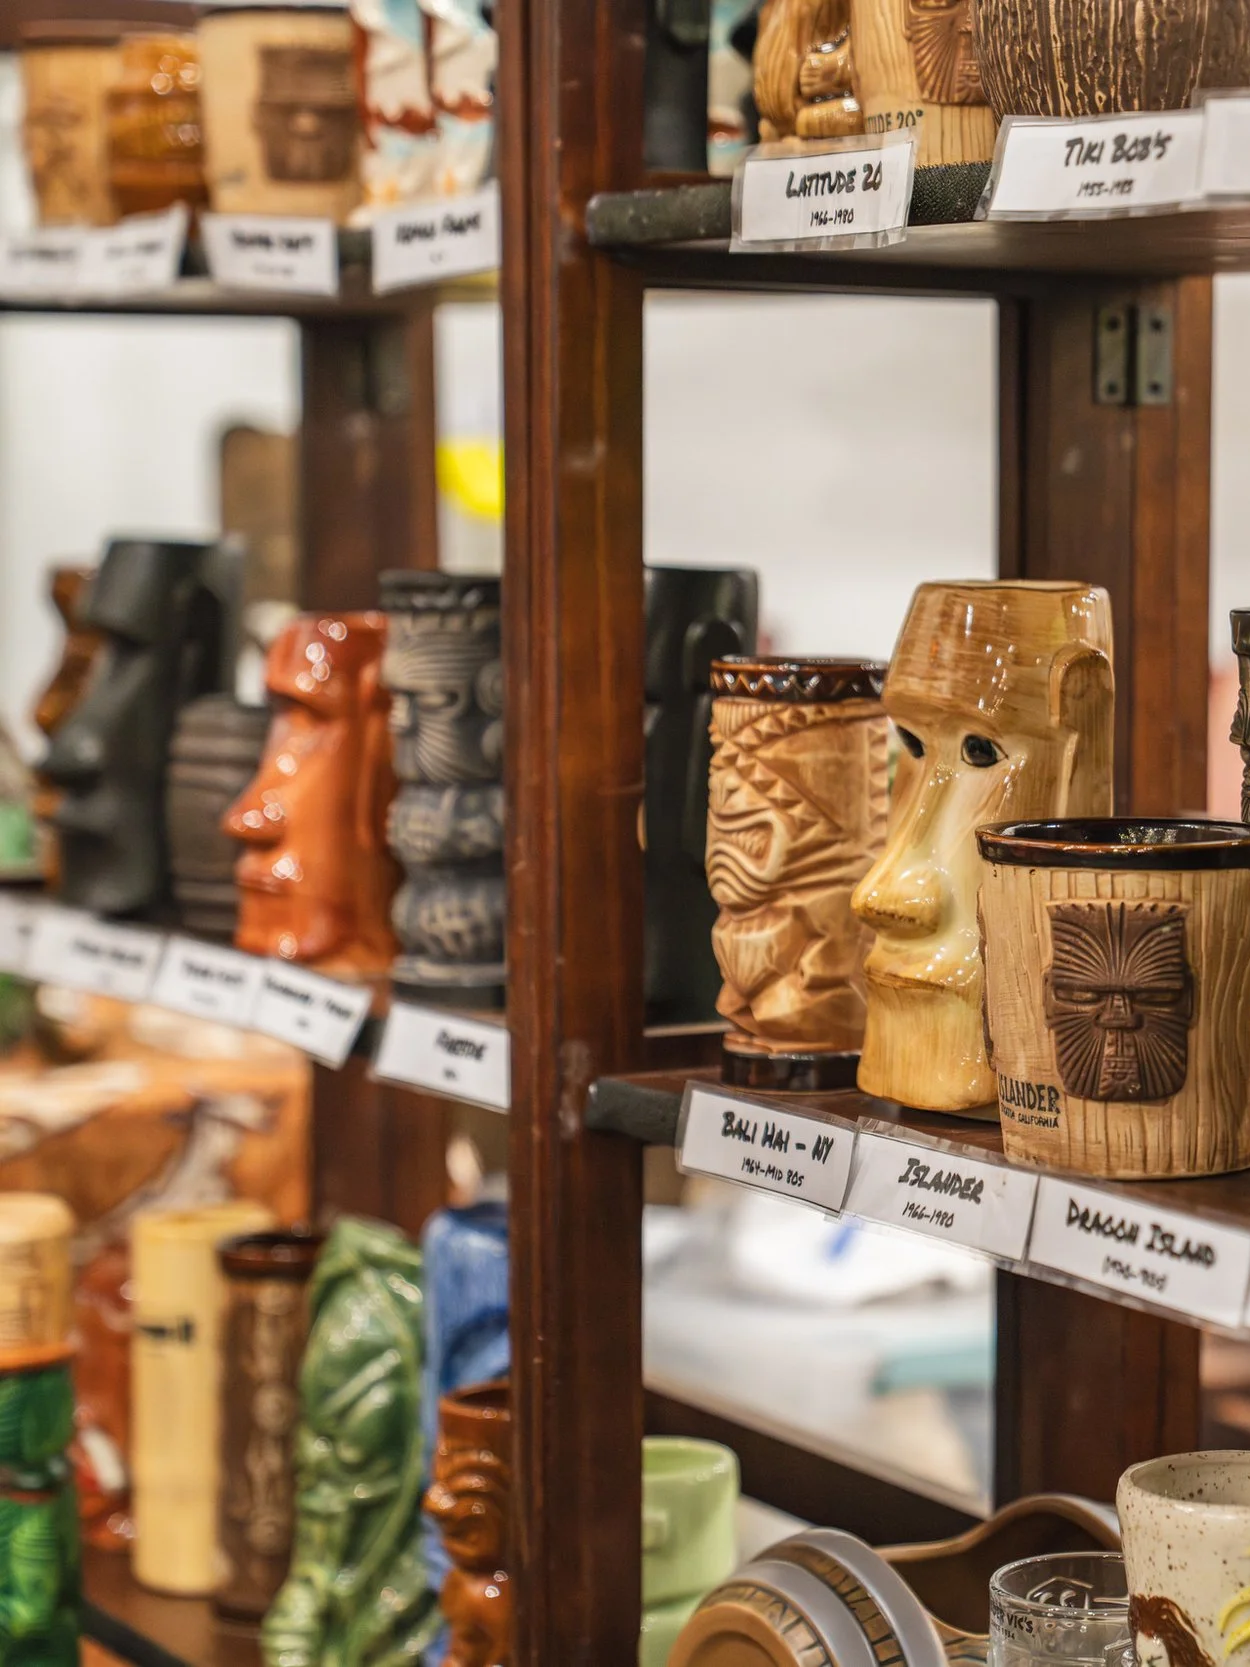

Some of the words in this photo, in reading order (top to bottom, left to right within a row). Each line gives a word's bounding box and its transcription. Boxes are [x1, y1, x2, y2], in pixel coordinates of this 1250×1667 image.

[1064, 136, 1105, 167] TIKI
[1111, 129, 1173, 165] BOB'S
[785, 167, 857, 199] LATITUDE
[862, 160, 883, 192] 20
[809, 208, 855, 227] 1966-1980
[721, 1110, 758, 1145] BALI
[761, 1121, 790, 1154] HAI
[811, 1134, 835, 1165] NY
[1018, 1112, 1060, 1129] CALIFORNIA
[741, 1157, 784, 1182] 1964-MID
[898, 1158, 985, 1205] ISLANDER
[902, 1202, 955, 1228] 1966-1980
[1066, 1198, 1141, 1246] DRAGON
[1145, 1223, 1217, 1269] ISLAND
